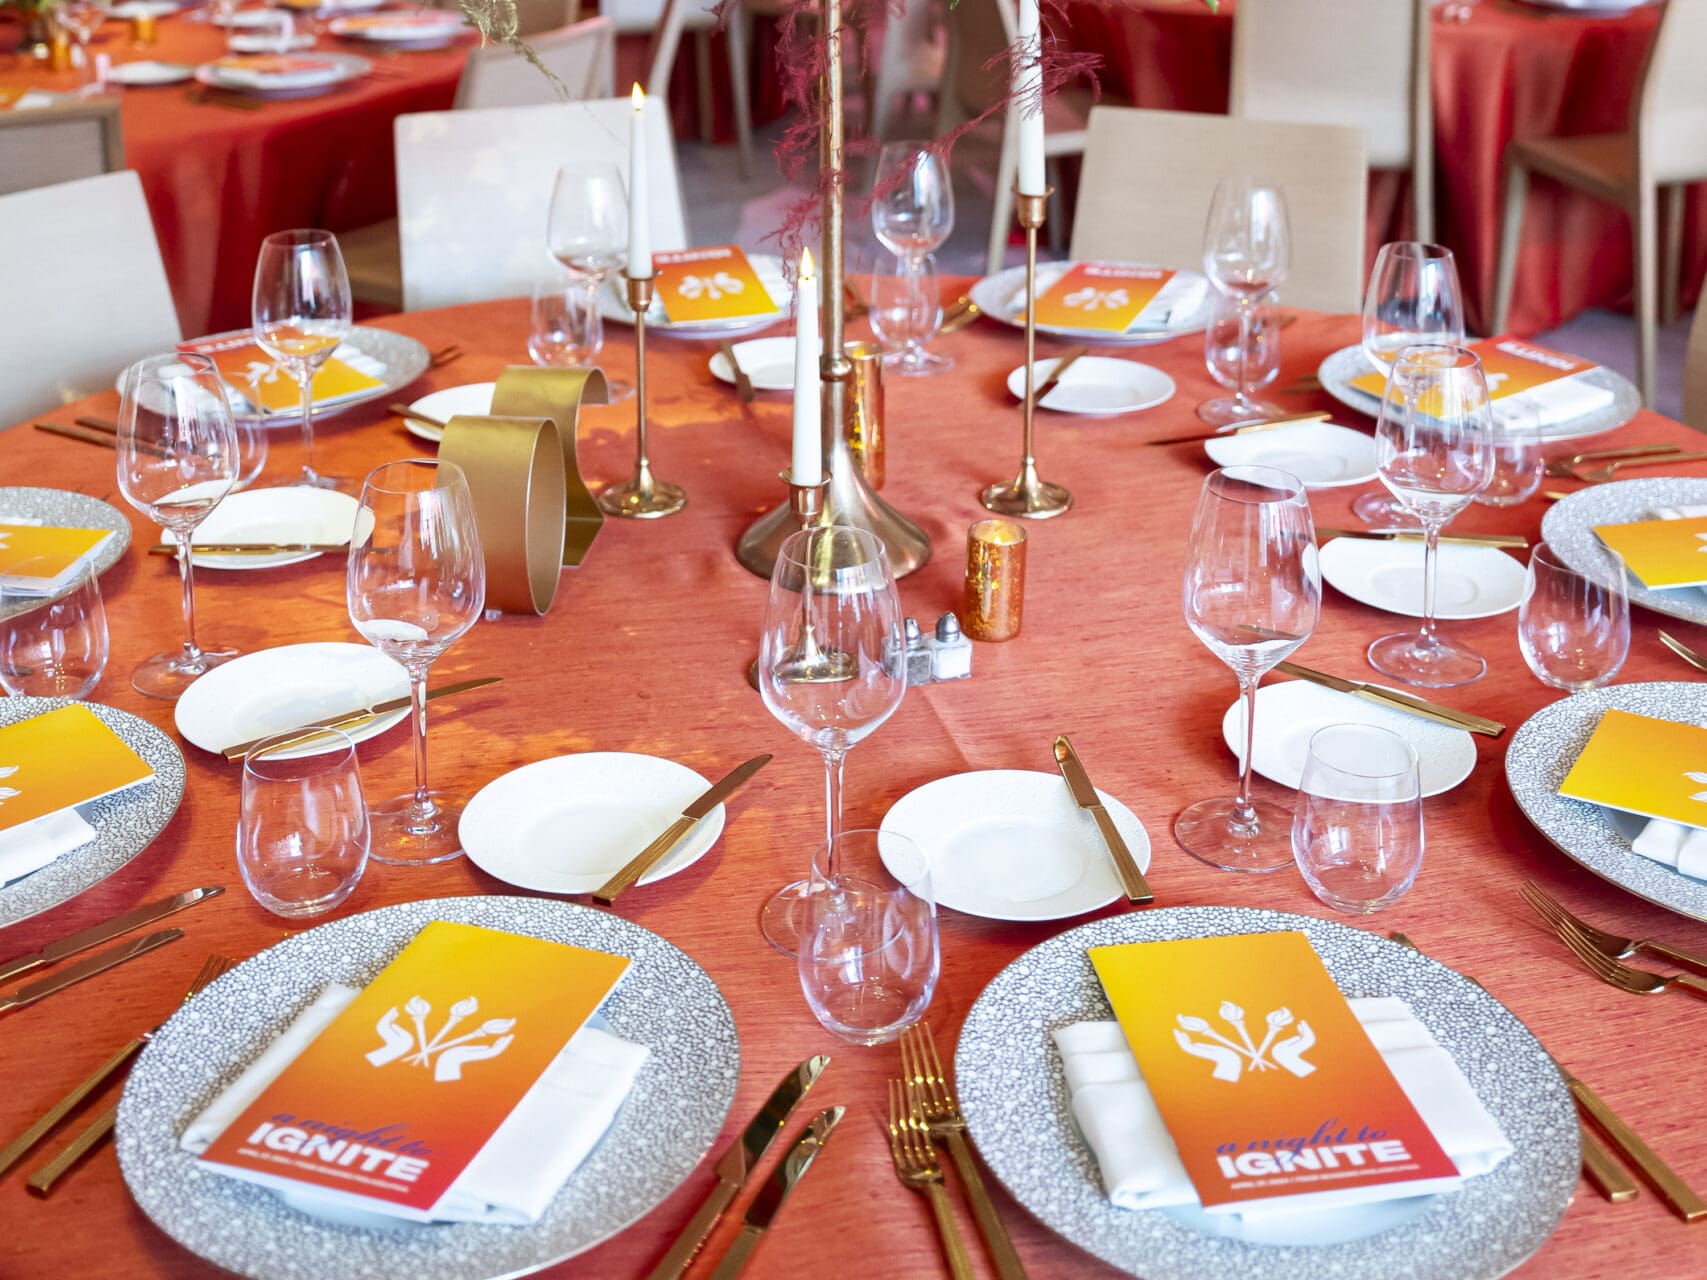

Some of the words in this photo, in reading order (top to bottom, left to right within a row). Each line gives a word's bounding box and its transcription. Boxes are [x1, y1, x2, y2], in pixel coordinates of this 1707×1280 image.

[247, 1122, 430, 1183] IGNITE
[1216, 1141, 1236, 1154] a
[1248, 1117, 1349, 1166] night
[1357, 1125, 1390, 1140] to
[1216, 1139, 1411, 1179] IGNITE
